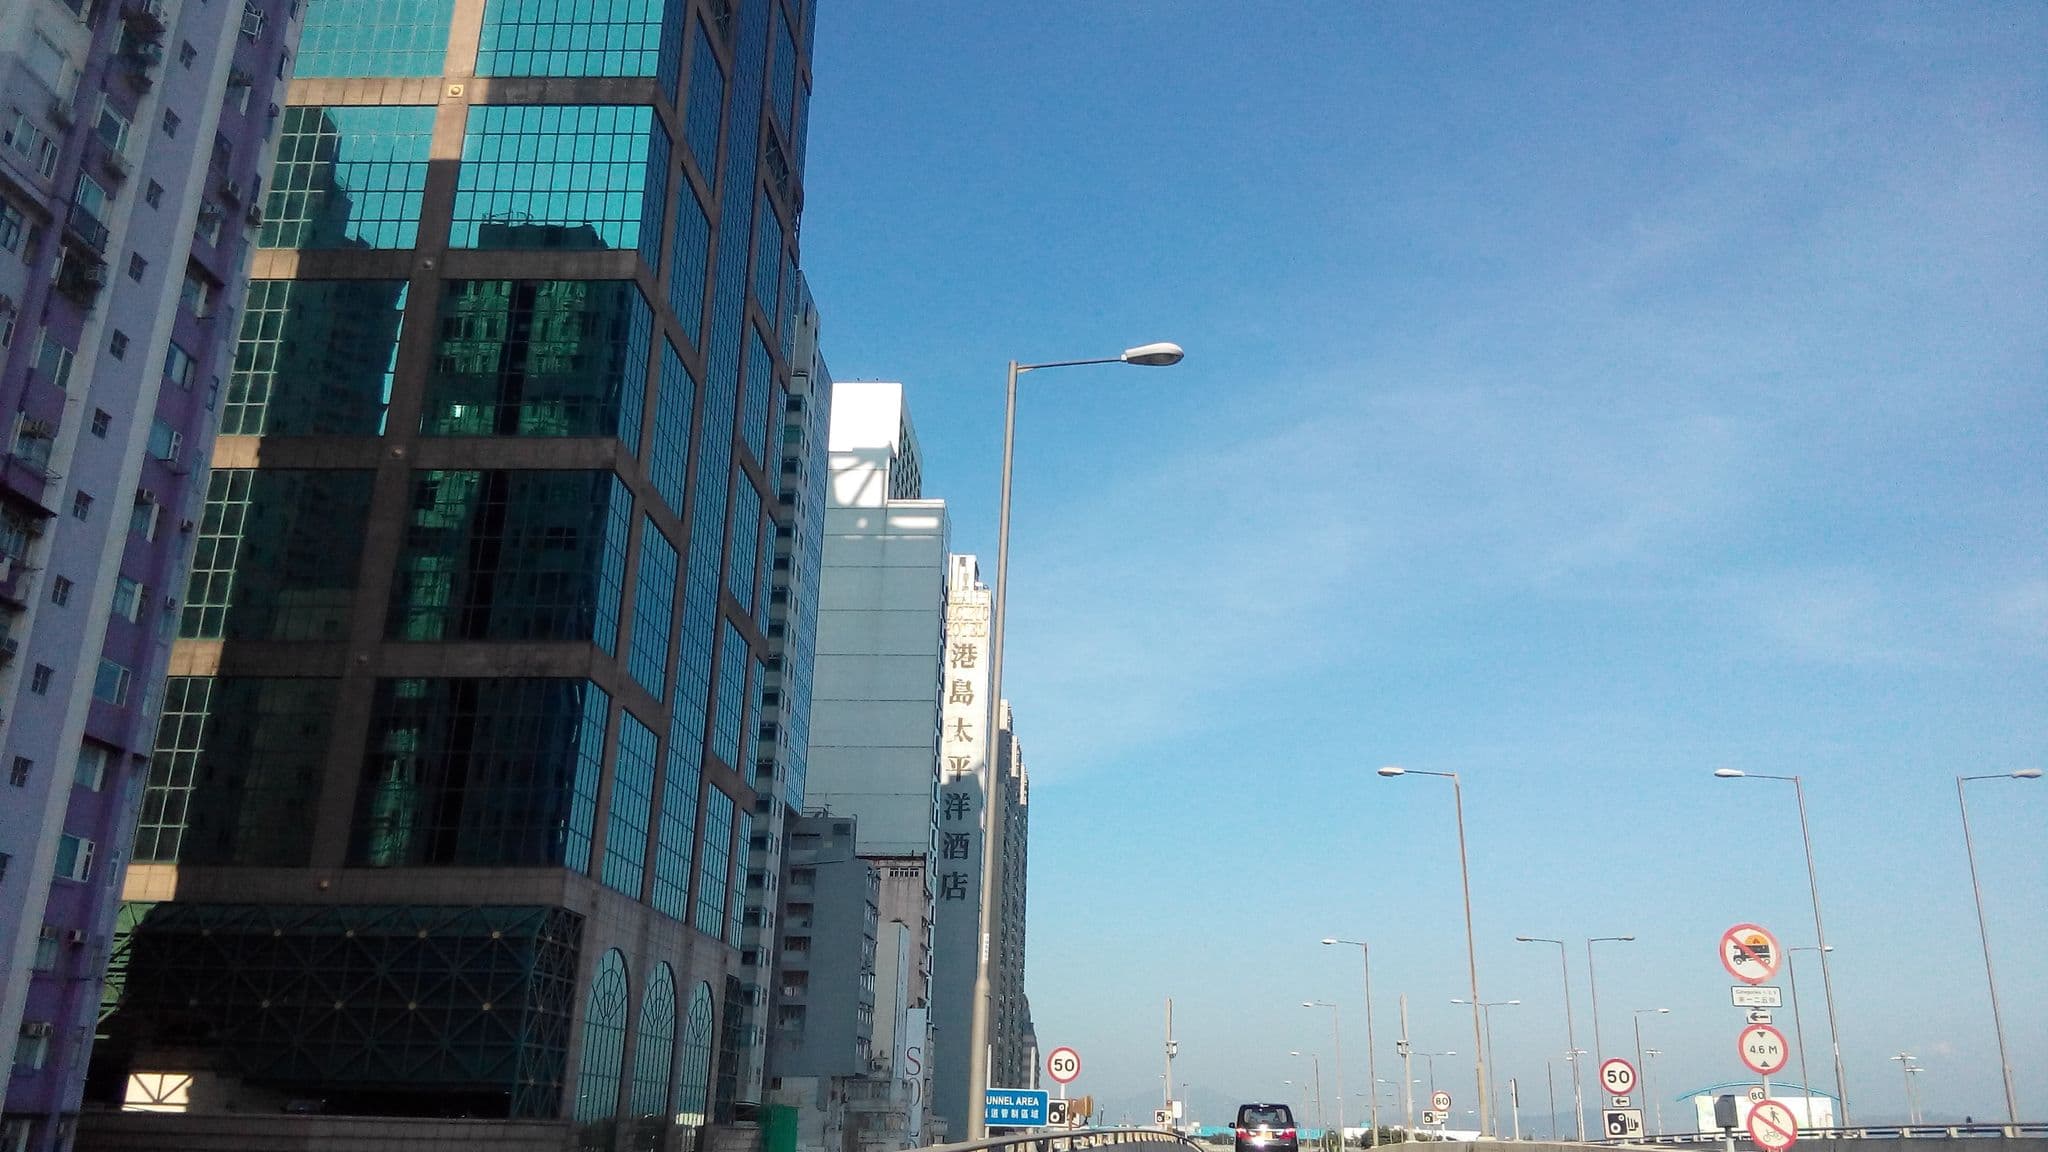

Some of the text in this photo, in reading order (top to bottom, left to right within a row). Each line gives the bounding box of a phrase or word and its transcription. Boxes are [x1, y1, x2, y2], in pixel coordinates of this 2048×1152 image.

[940, 642, 977, 901] 港島太平洋酒店
[1749, 1045, 1778, 1055] 4.6 M
[1054, 1058, 1075, 1072] 50
[1607, 1070, 1630, 1084] 50
[1751, 1091, 1765, 1100] 80
[986, 1096, 1039, 1107] UNNEL AREA
[1435, 1097, 1449, 1106] 80
